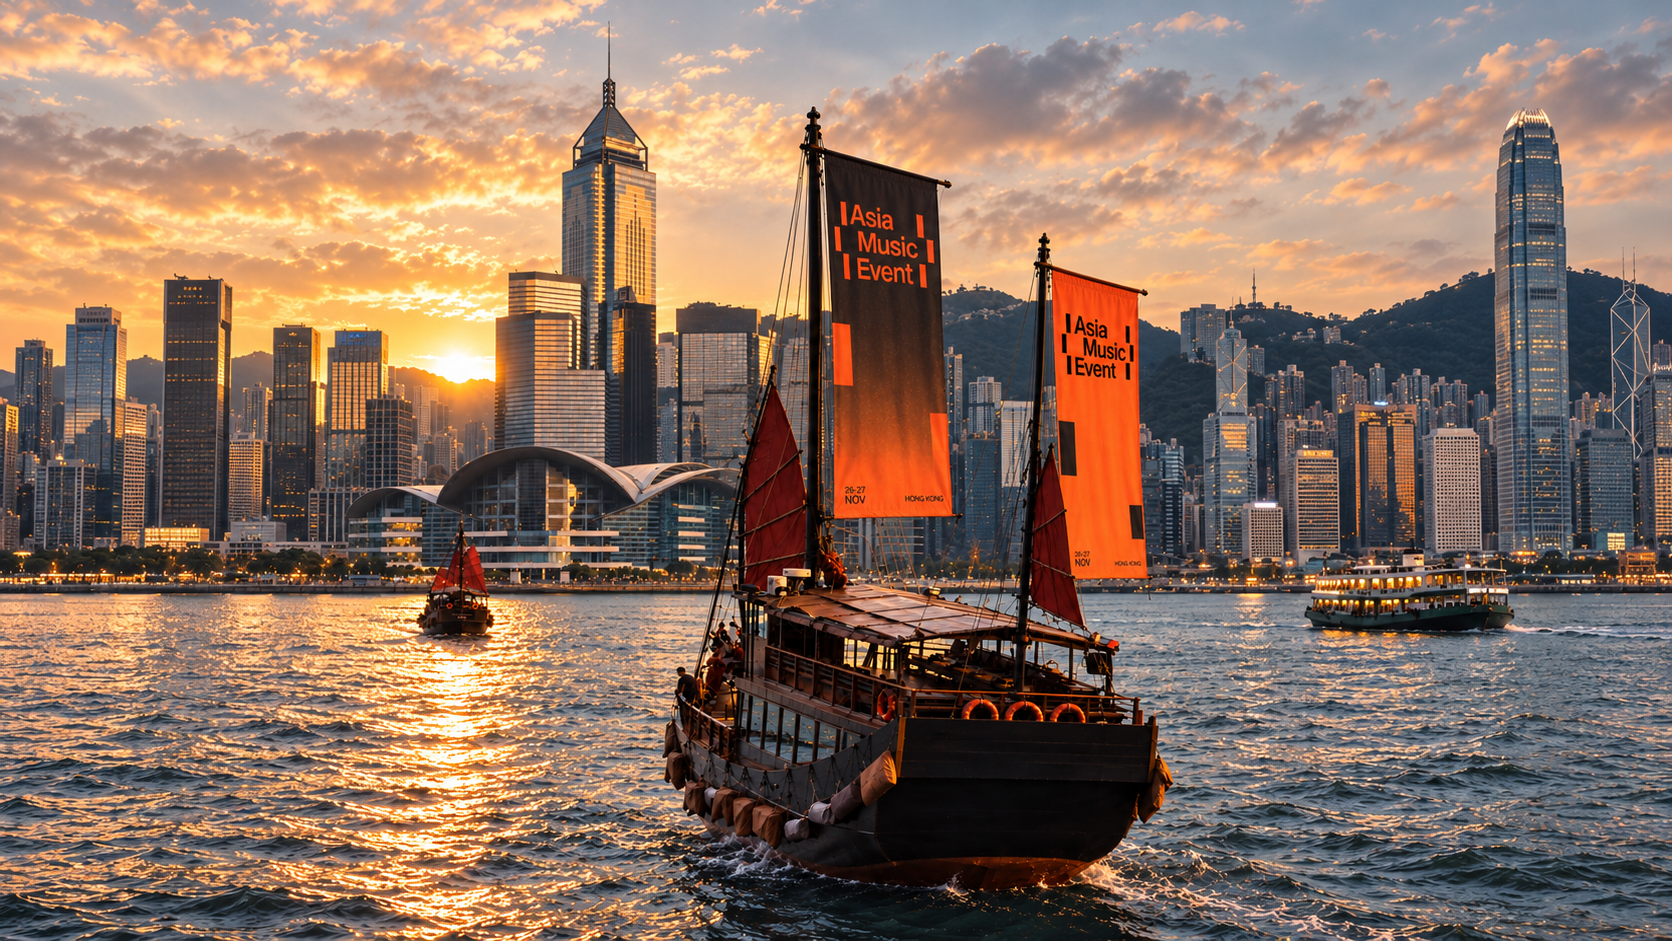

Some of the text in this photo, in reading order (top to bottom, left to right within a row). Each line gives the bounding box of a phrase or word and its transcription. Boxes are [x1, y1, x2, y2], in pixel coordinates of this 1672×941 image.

[850, 204, 894, 231] Asia
[857, 230, 919, 259] Music
[857, 257, 914, 285] Event
[1074, 315, 1108, 339] Asia
[1083, 337, 1126, 361] Music
[1075, 356, 1117, 379] Event
[844, 495, 866, 505] NOV
[1074, 558, 1091, 567] NOV
